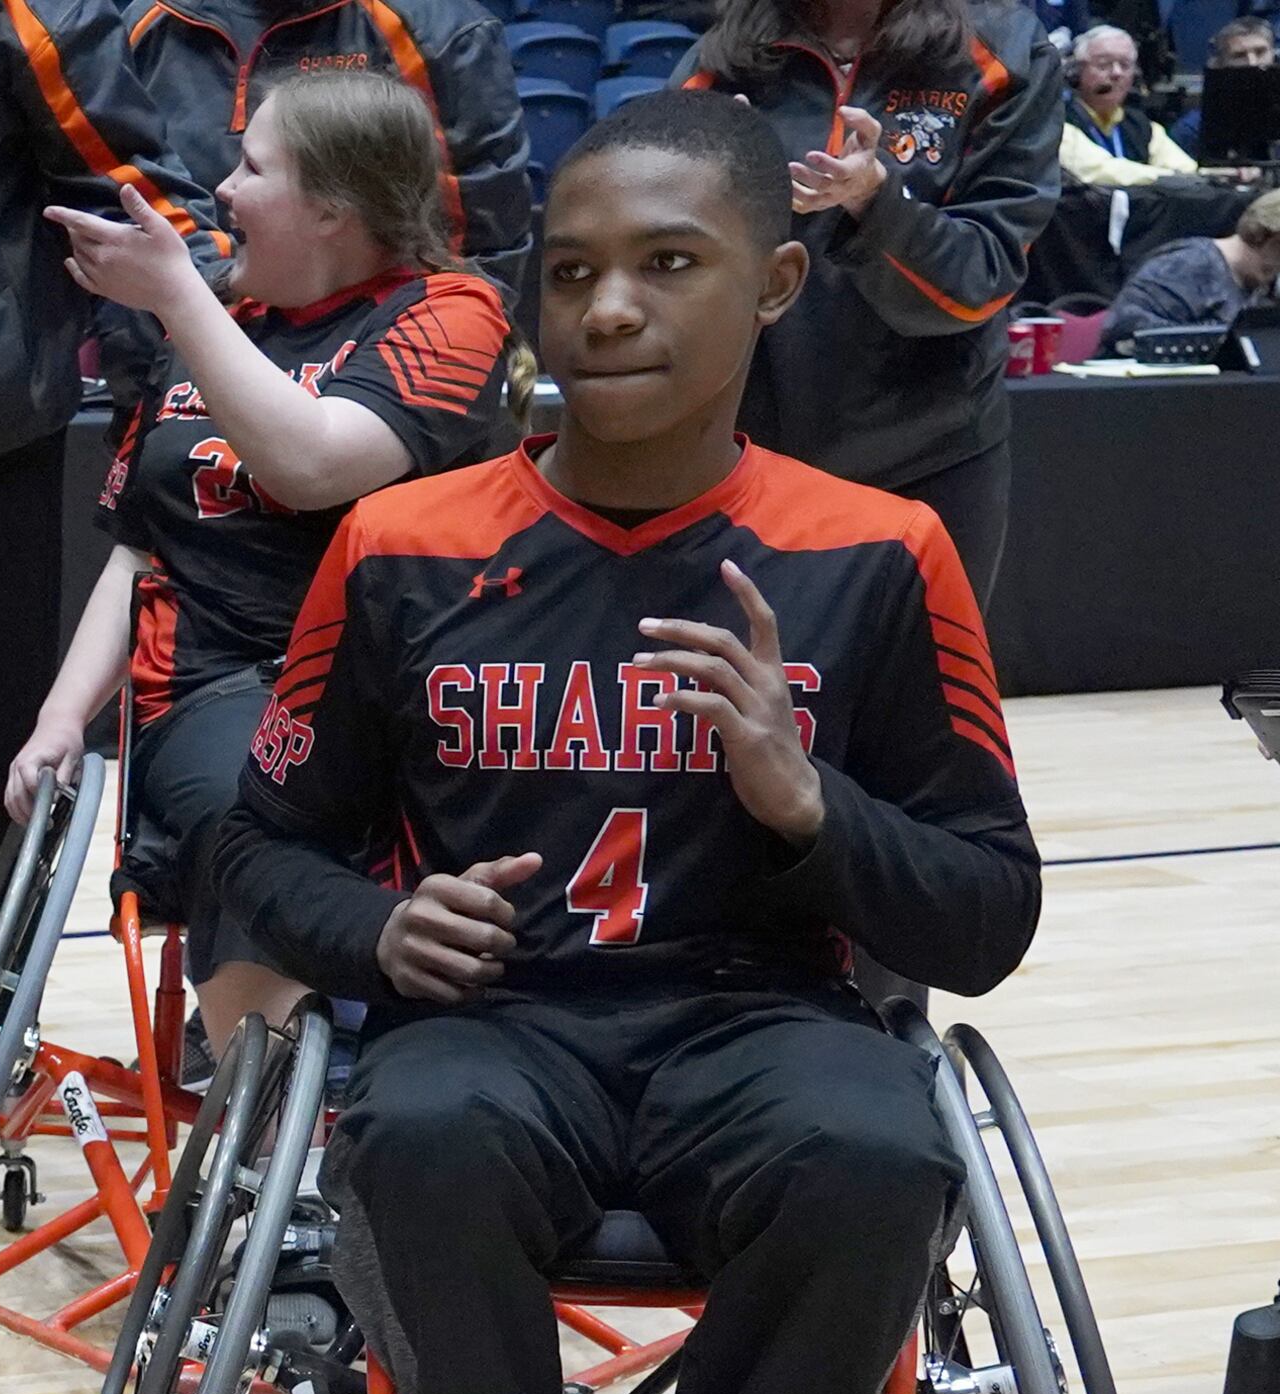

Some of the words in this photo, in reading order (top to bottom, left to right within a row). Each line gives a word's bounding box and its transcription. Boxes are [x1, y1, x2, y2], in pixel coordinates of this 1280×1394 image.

[885, 89, 968, 117] SHARKS
[565, 807, 649, 945] 4
[63, 1086, 92, 1135] Eagle
